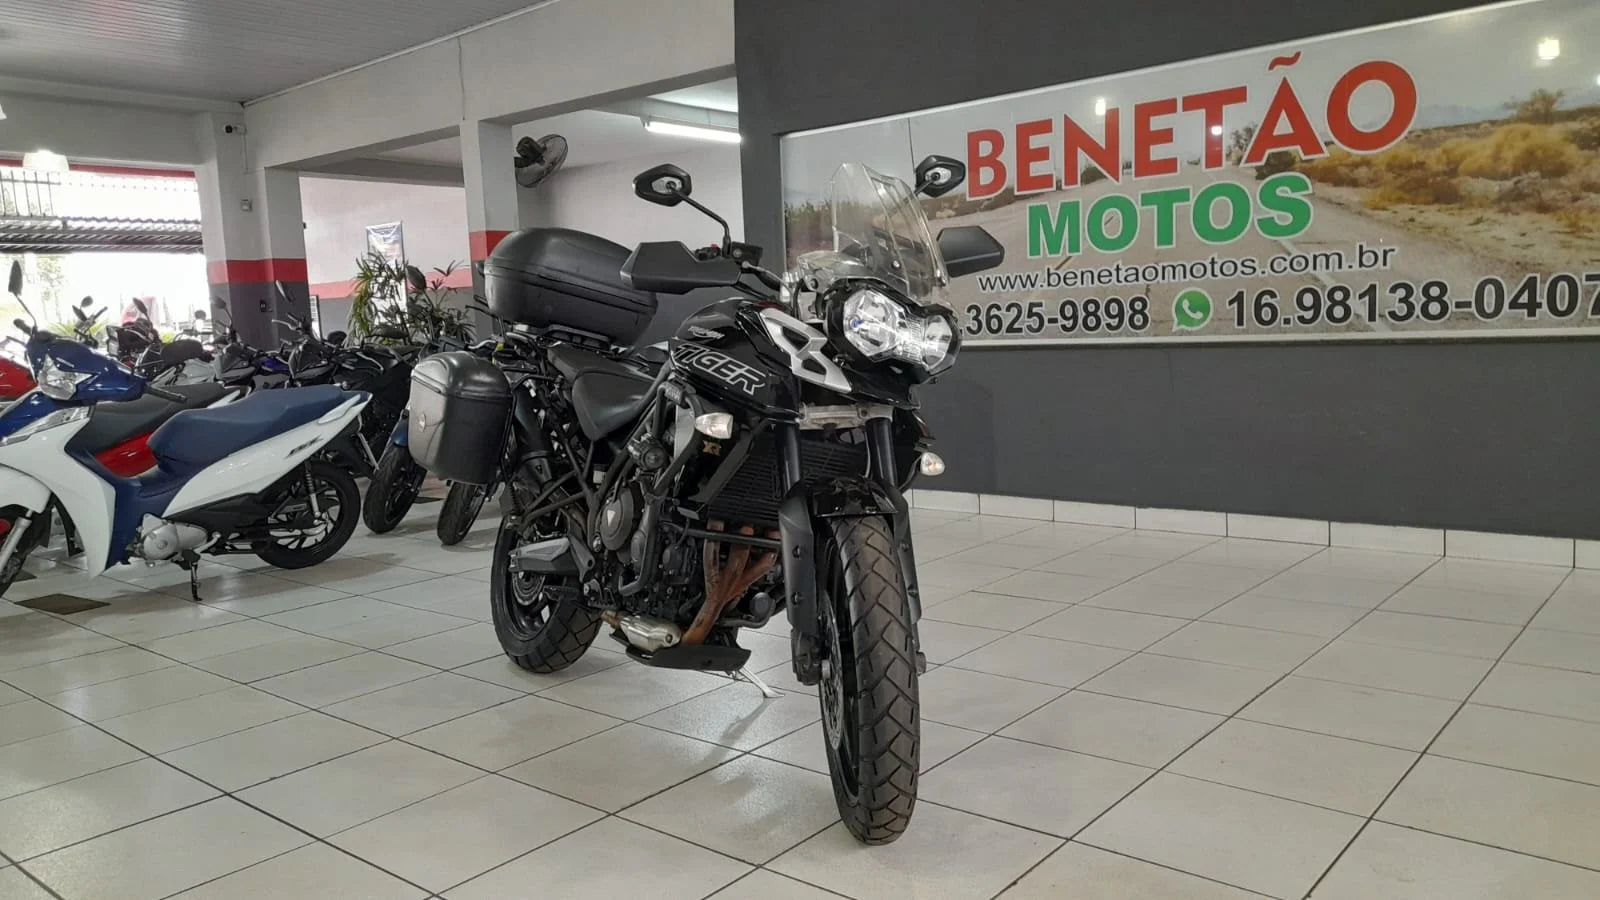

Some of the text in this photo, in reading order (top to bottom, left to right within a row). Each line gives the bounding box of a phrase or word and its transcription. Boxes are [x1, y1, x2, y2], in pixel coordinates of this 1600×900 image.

[967, 51, 1417, 198] BENETÃO
[1028, 172, 1312, 257] MOTOS
[979, 244, 1396, 291] www.benetaomotos.com.br
[673, 343, 767, 395] TIGER
